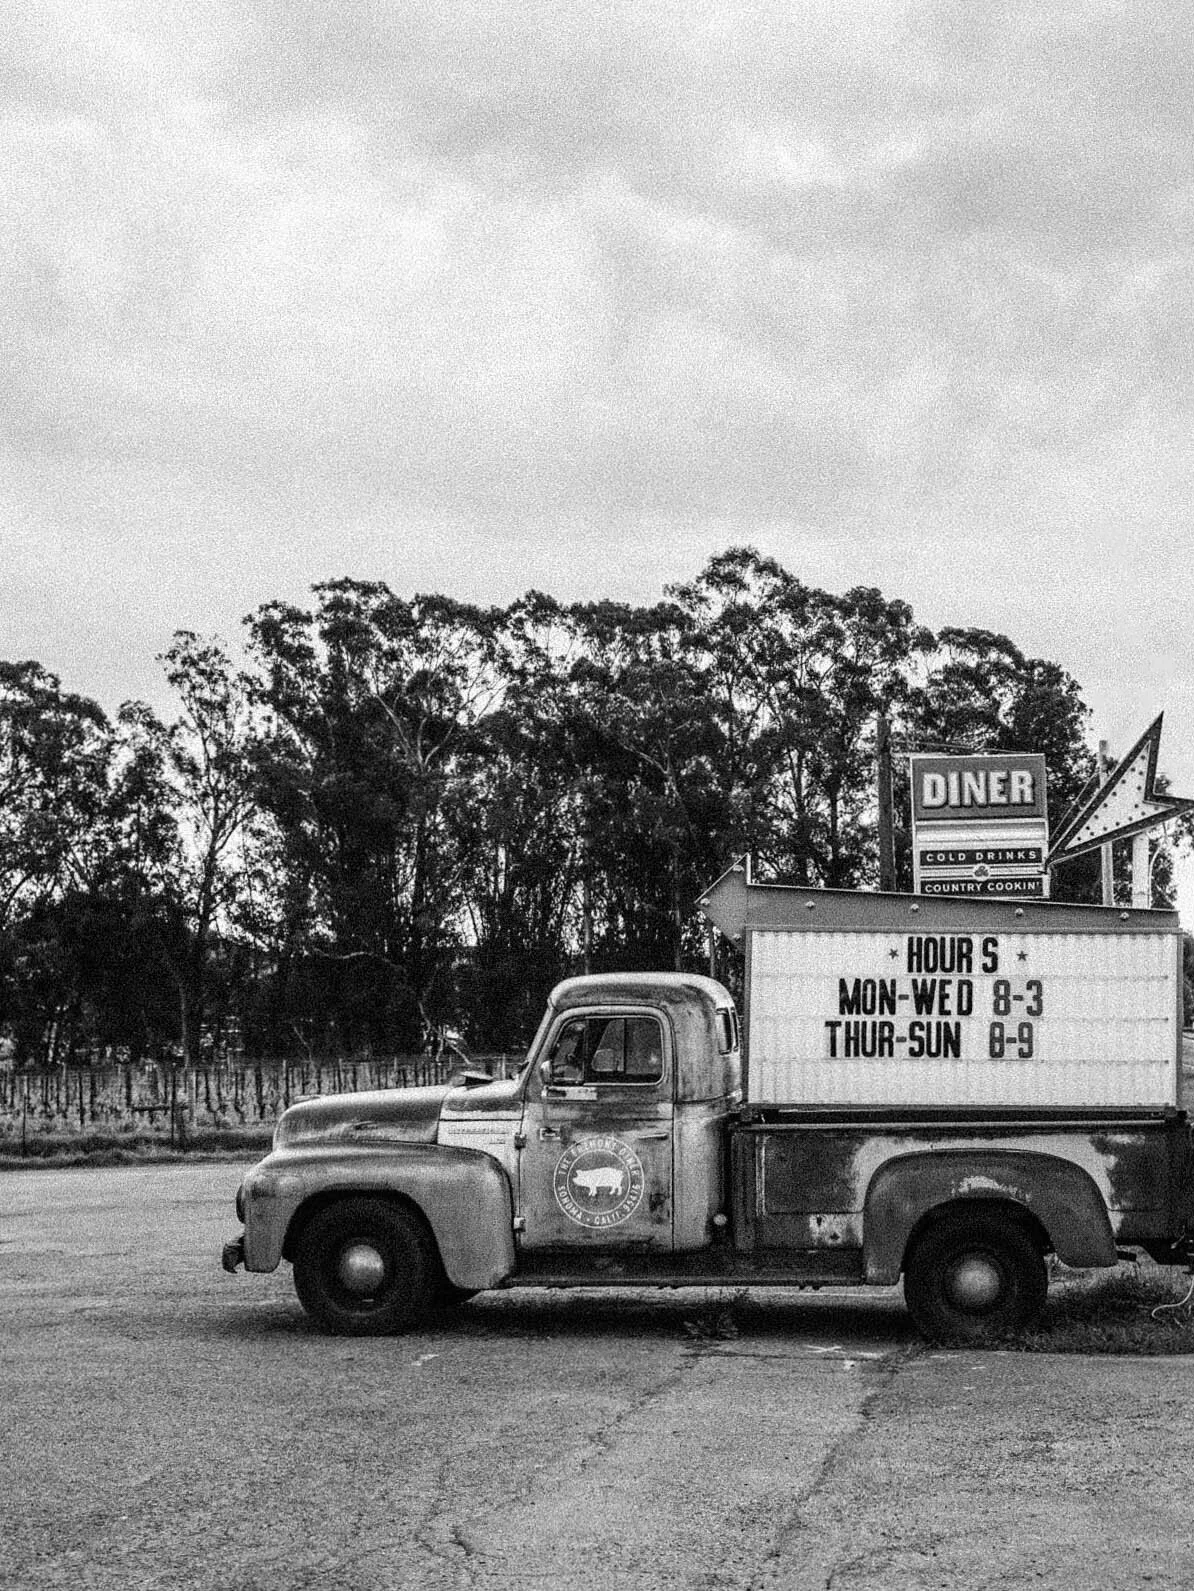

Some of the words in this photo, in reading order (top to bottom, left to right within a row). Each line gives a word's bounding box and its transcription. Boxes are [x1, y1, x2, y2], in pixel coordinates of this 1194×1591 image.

[922, 769, 1035, 808] DINER
[926, 853, 966, 862] COLD
[975, 850, 1037, 861] DRINKS
[925, 882, 983, 893] COUNTRY
[987, 881, 1040, 891] COOKIN'
[907, 936, 999, 974] HOURS
[838, 978, 974, 1016] MON-WED
[992, 979, 1044, 1017] 8-3
[824, 1020, 962, 1058] THUR-SUN
[989, 1021, 1034, 1059] 8-9
[558, 1158, 572, 1175] THE
[570, 1138, 617, 1157] FREMONT
[619, 1147, 641, 1176] DINER
[558, 1185, 583, 1220] SONOMA
